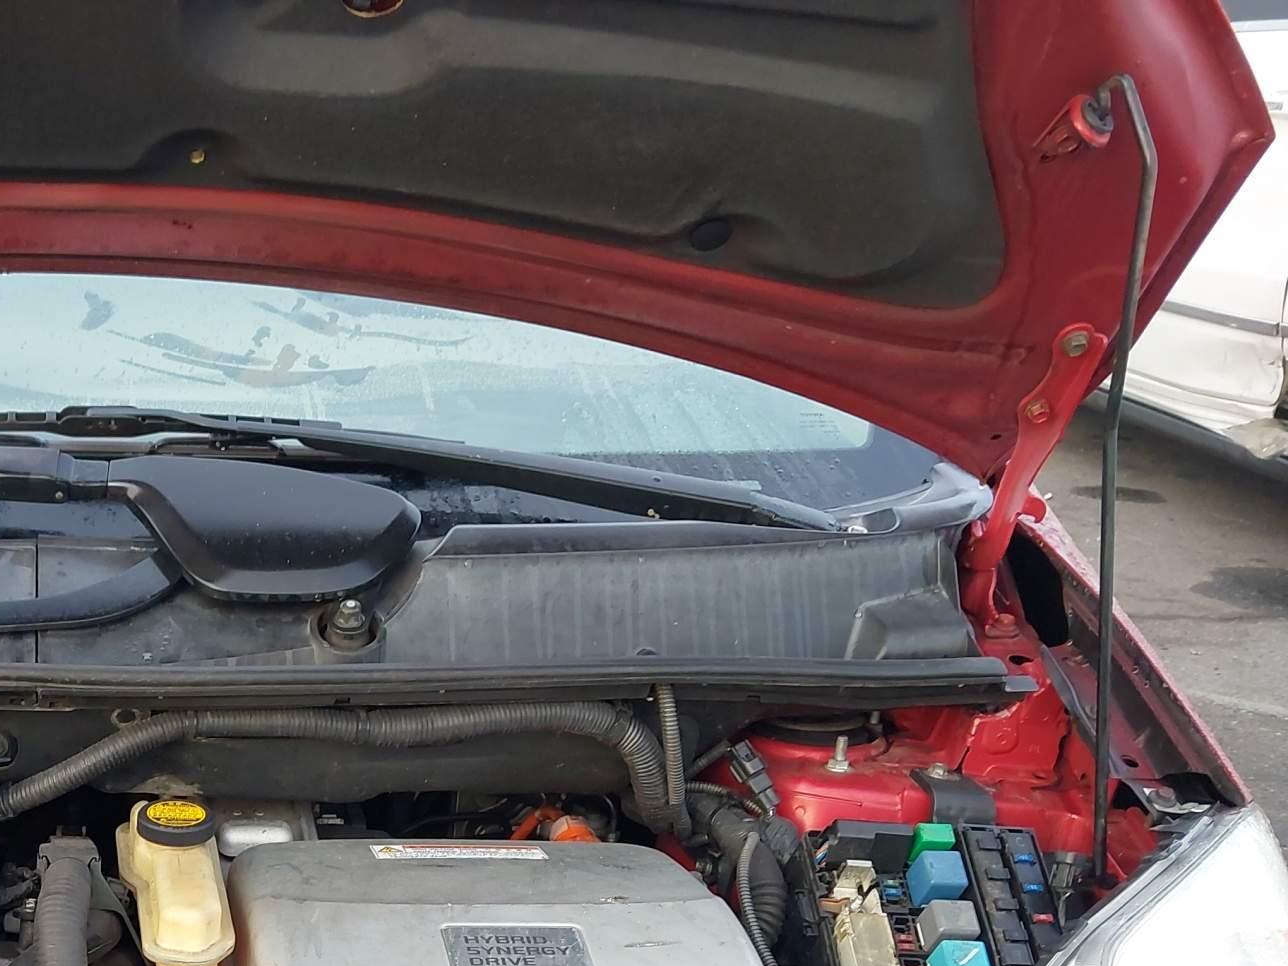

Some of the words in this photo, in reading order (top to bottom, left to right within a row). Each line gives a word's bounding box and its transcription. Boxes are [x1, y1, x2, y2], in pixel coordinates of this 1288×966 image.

[463, 935, 548, 945] HYBRID
[466, 946, 569, 956] SYNERGY
[469, 957, 537, 966] DRIVE
